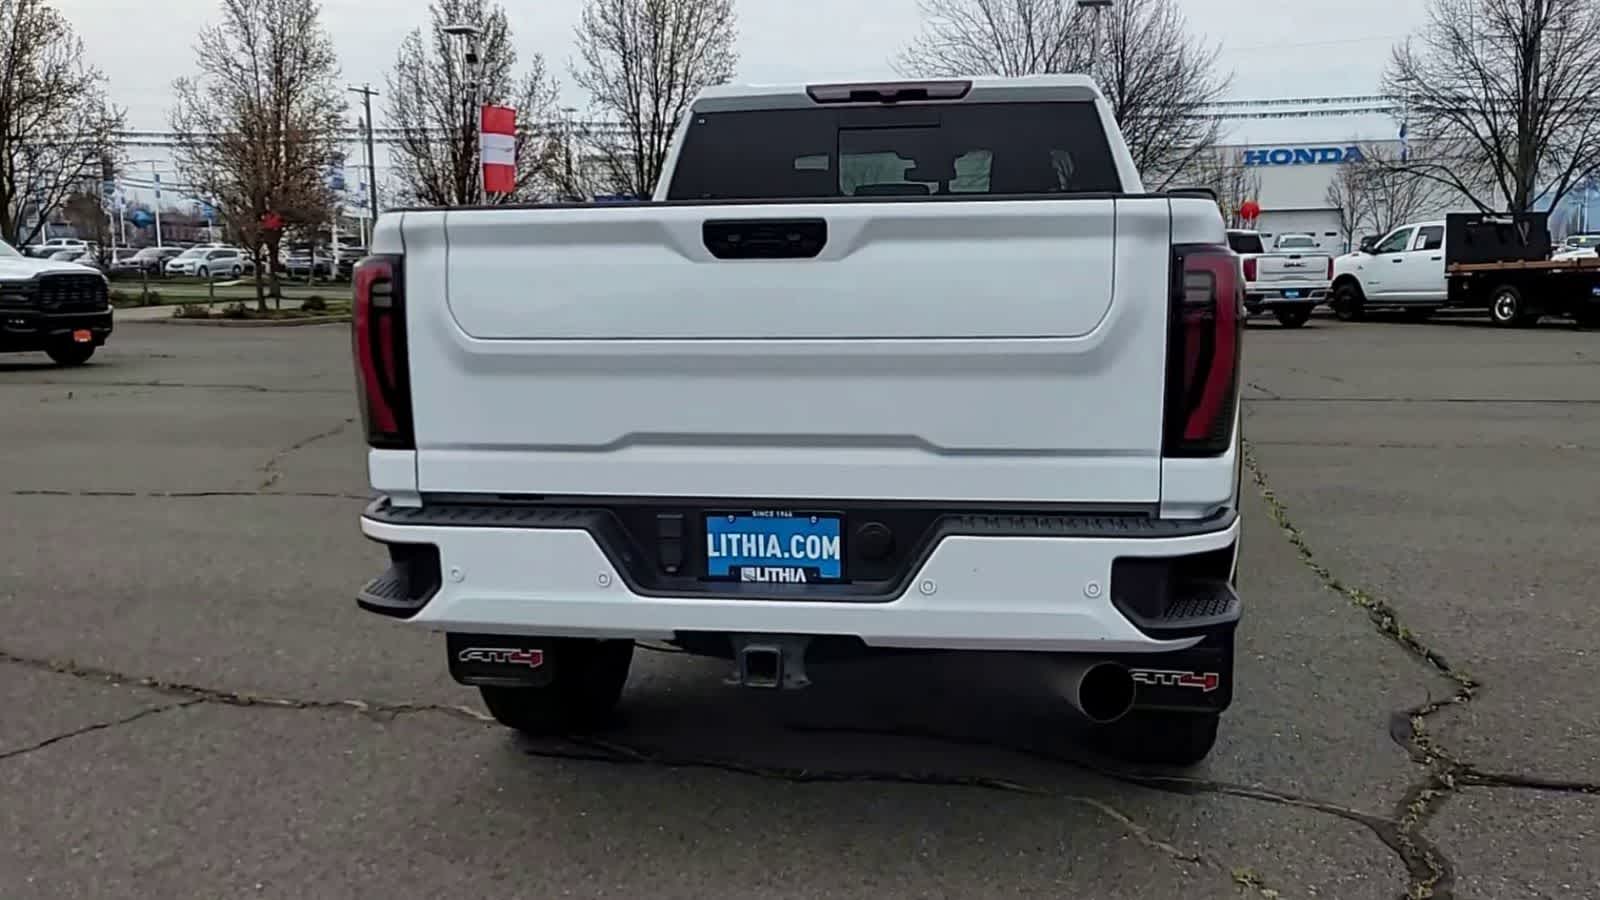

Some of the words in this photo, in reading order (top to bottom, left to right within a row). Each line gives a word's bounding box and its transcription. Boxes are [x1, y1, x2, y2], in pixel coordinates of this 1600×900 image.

[1242, 146, 1366, 166] HONDA
[752, 510, 774, 518] SINCE
[707, 533, 840, 560] LITHIA.COM
[757, 567, 807, 583] LITHIA
[459, 647, 543, 668] AT4
[1128, 667, 1219, 692] AT4
